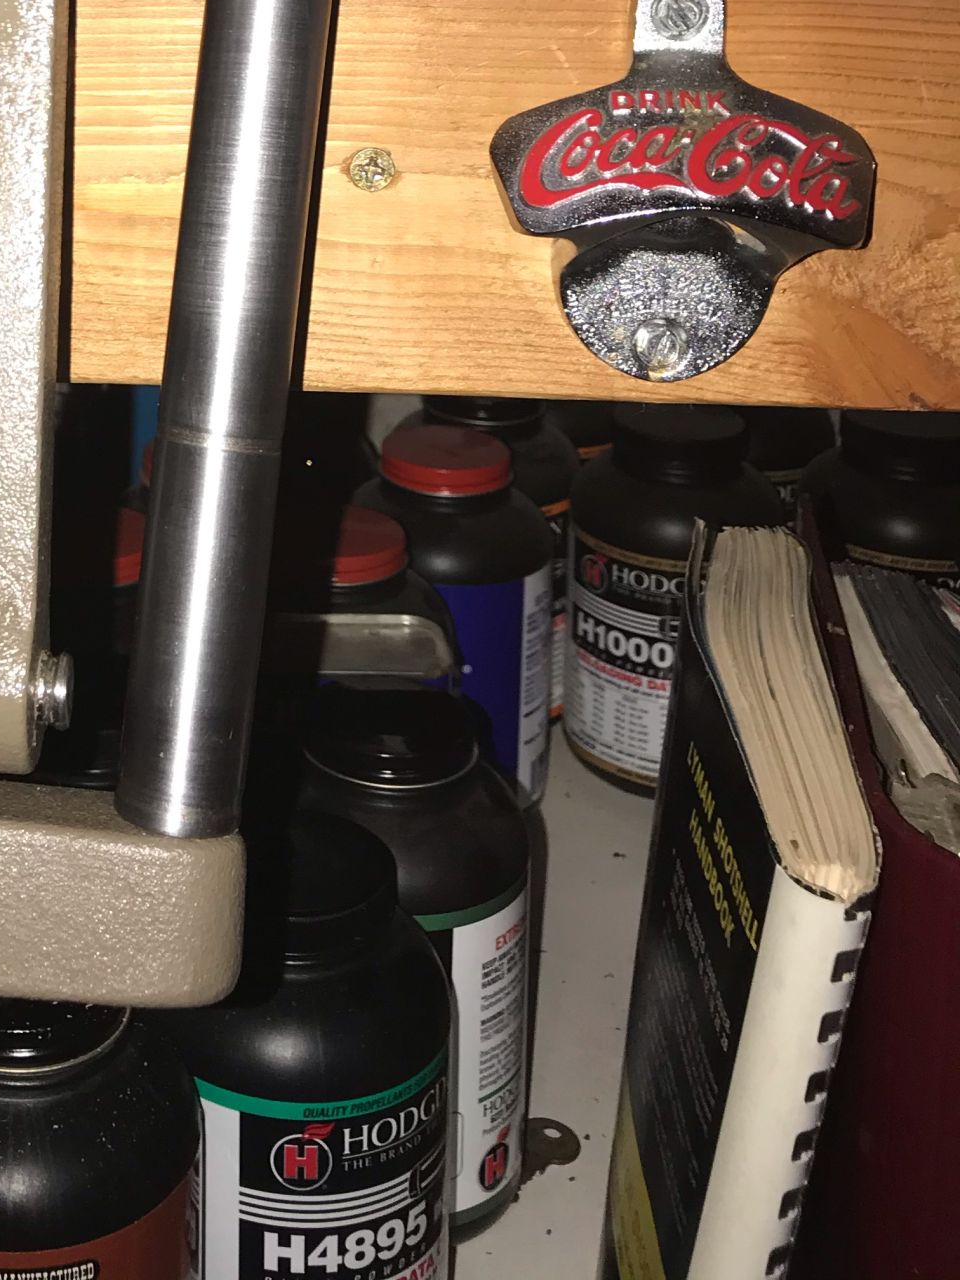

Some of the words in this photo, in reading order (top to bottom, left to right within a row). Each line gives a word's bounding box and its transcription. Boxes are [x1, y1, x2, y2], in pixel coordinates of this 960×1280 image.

[611, 89, 733, 117] DRINK
[576, 610, 674, 669] H1000
[687, 739, 716, 824] LYMAN
[689, 807, 735, 948] HANDBOOK
[713, 817, 759, 952] SHOTSHELL
[303, 1105, 349, 1119] QUALITY
[341, 1156, 373, 1172] THE
[263, 1199, 428, 1275] H4895
